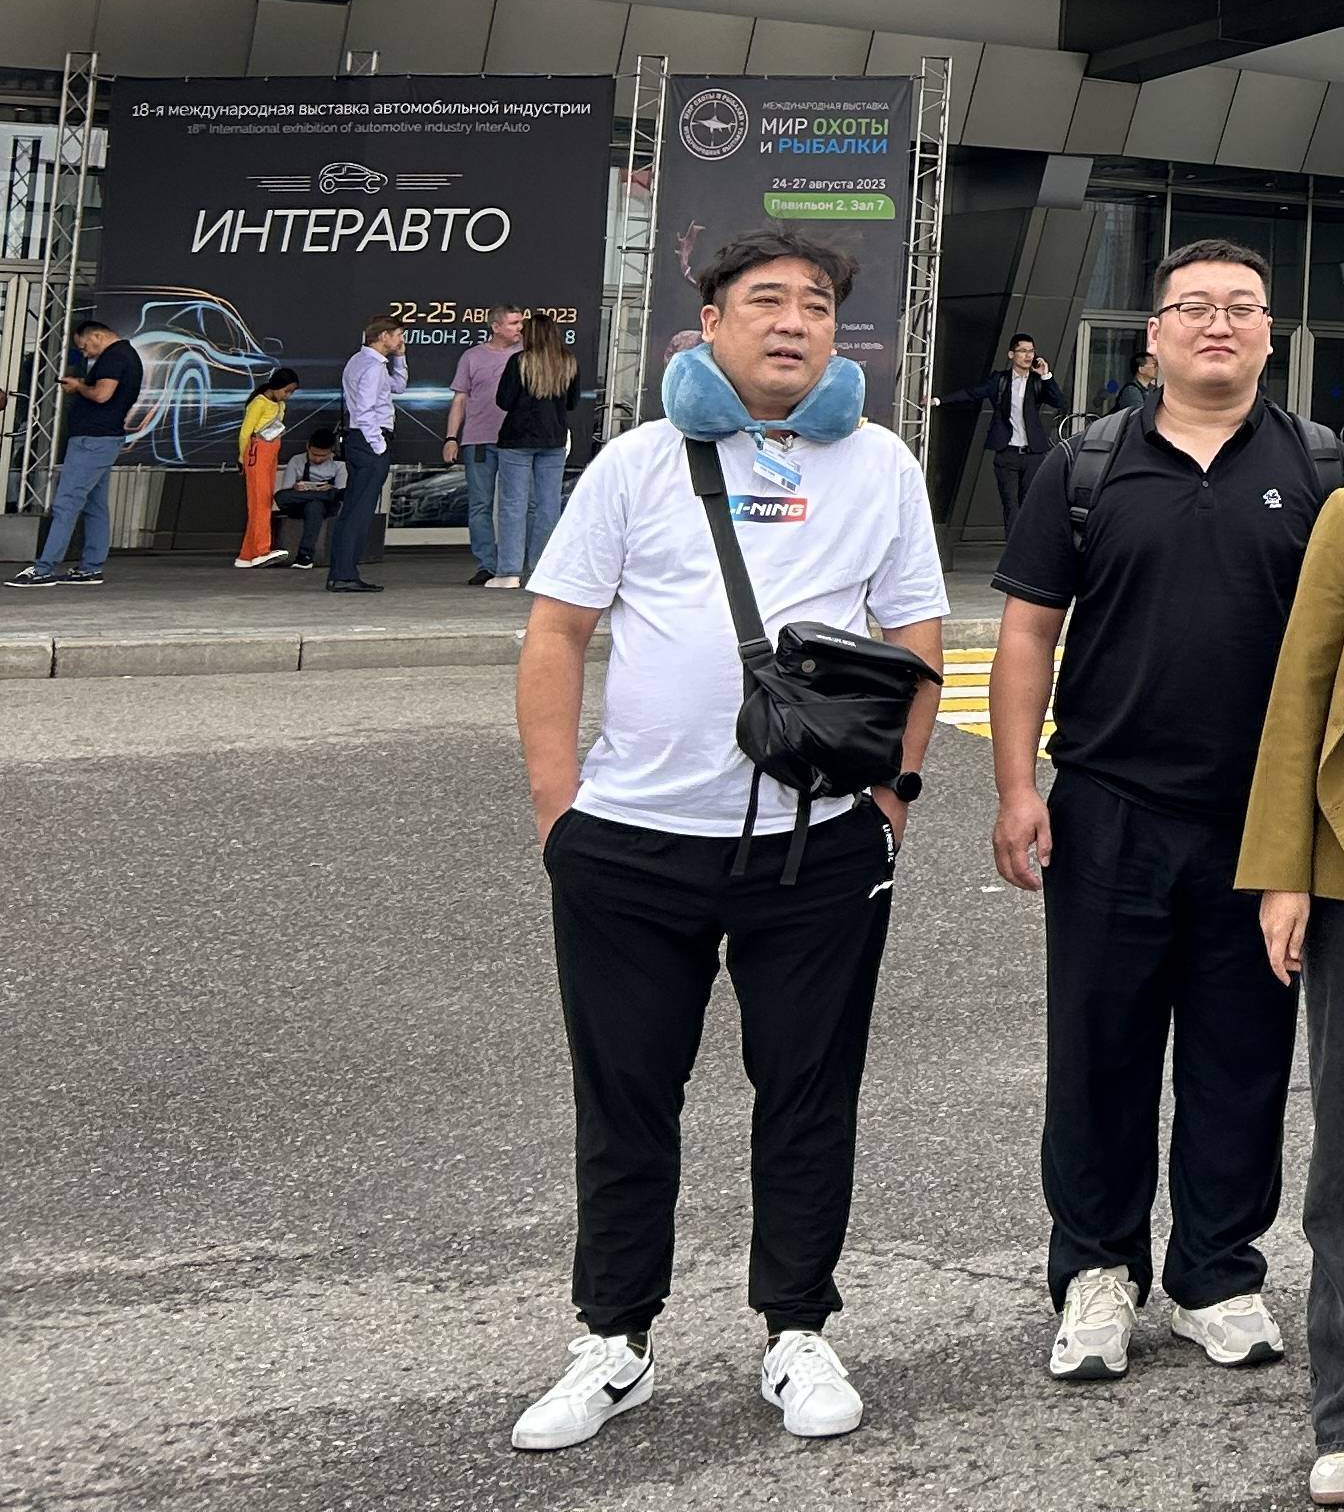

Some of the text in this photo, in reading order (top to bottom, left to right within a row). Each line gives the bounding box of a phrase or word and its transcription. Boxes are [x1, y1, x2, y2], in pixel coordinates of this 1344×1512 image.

[131, 99, 592, 120] 18-я международная выставка автомобильной индустрии
[762, 101, 890, 112] МЕЖДУНАРОДНАЯ ВЫСТАВКА
[209, 122, 280, 134] International
[282, 121, 338, 134] exhibition
[340, 121, 352, 133] of
[354, 121, 422, 133] automotive
[423, 121, 473, 136] industry
[475, 120, 531, 133] InterAuto
[761, 118, 889, 136] МИР ОХОТЫ
[778, 137, 888, 154] РЫБАЛКИ
[772, 178, 886, 191] 24-27 августа 2023
[771, 199, 833, 210] Павильон
[850, 199, 874, 211] Зал
[876, 199, 885, 211] 7
[191, 206, 511, 254] ИНТЕРАВТО
